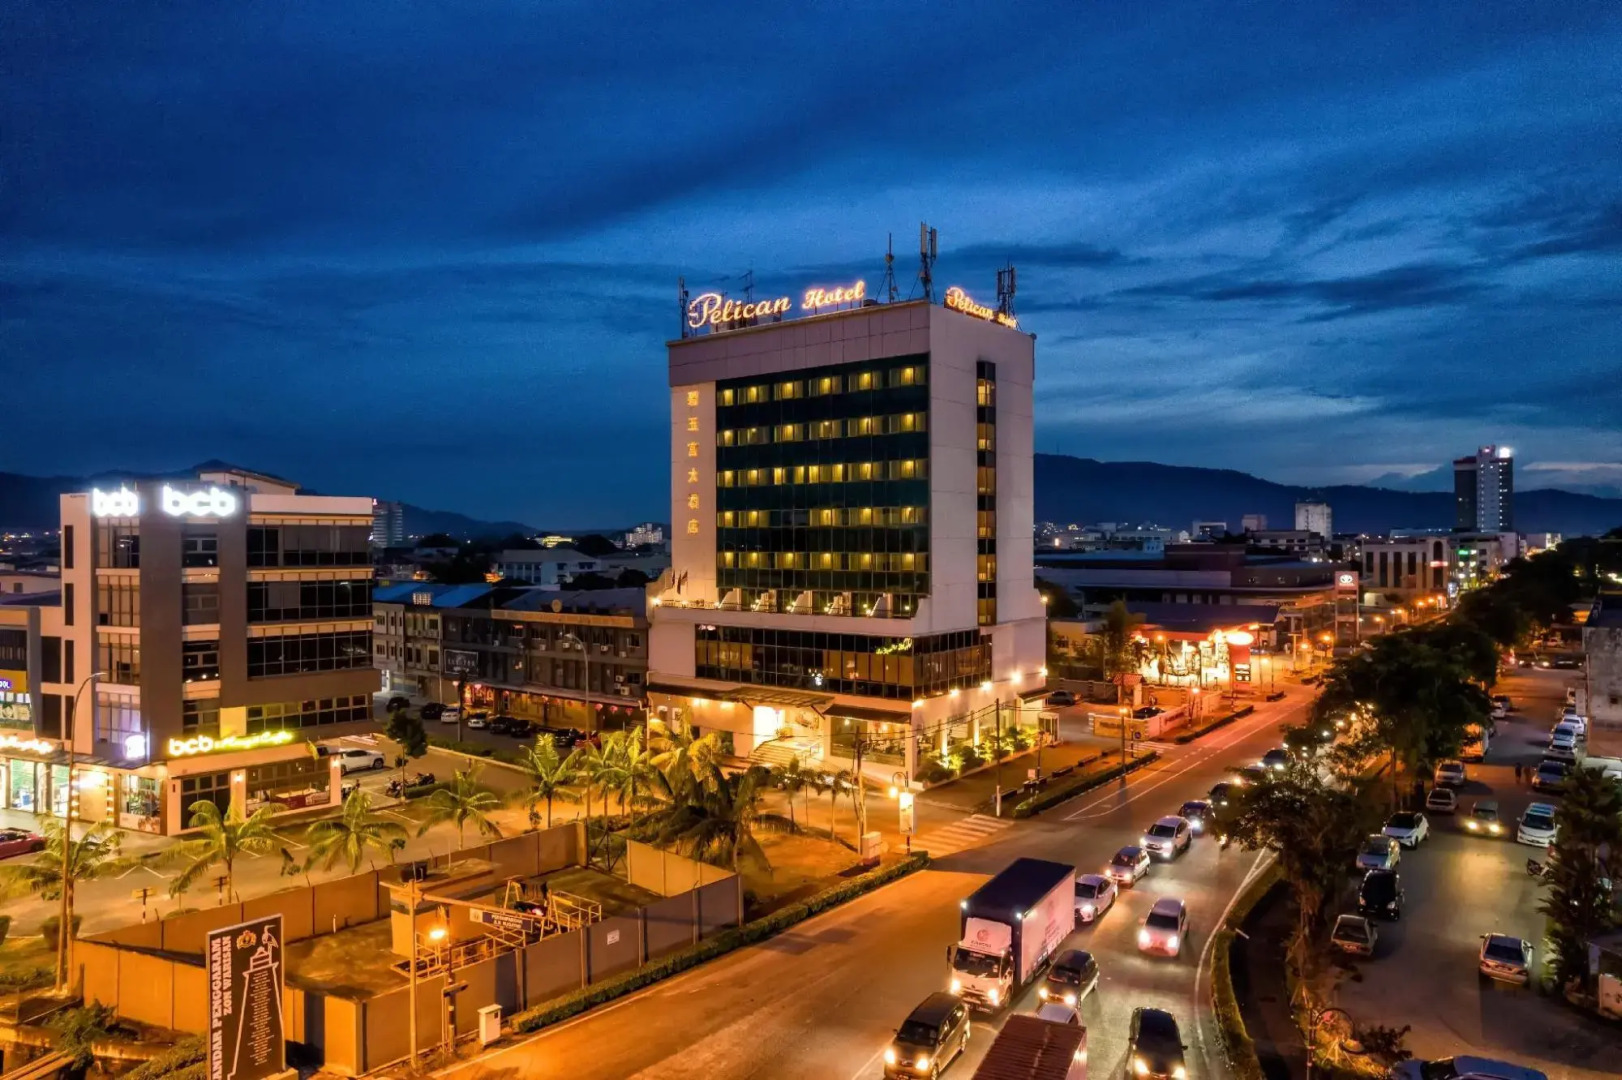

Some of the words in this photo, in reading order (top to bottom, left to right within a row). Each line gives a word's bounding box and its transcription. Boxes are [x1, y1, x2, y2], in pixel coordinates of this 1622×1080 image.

[689, 292, 792, 328] Pelican
[802, 280, 865, 309] Hotel
[945, 286, 995, 320] Pelican
[92, 486, 139, 517] bcb
[162, 484, 237, 517] bcb
[168, 734, 215, 757] bcb
[222, 935, 232, 990] WARISAN
[211, 938, 222, 1029] PENGGARAM
[222, 990, 232, 1016] ZON
